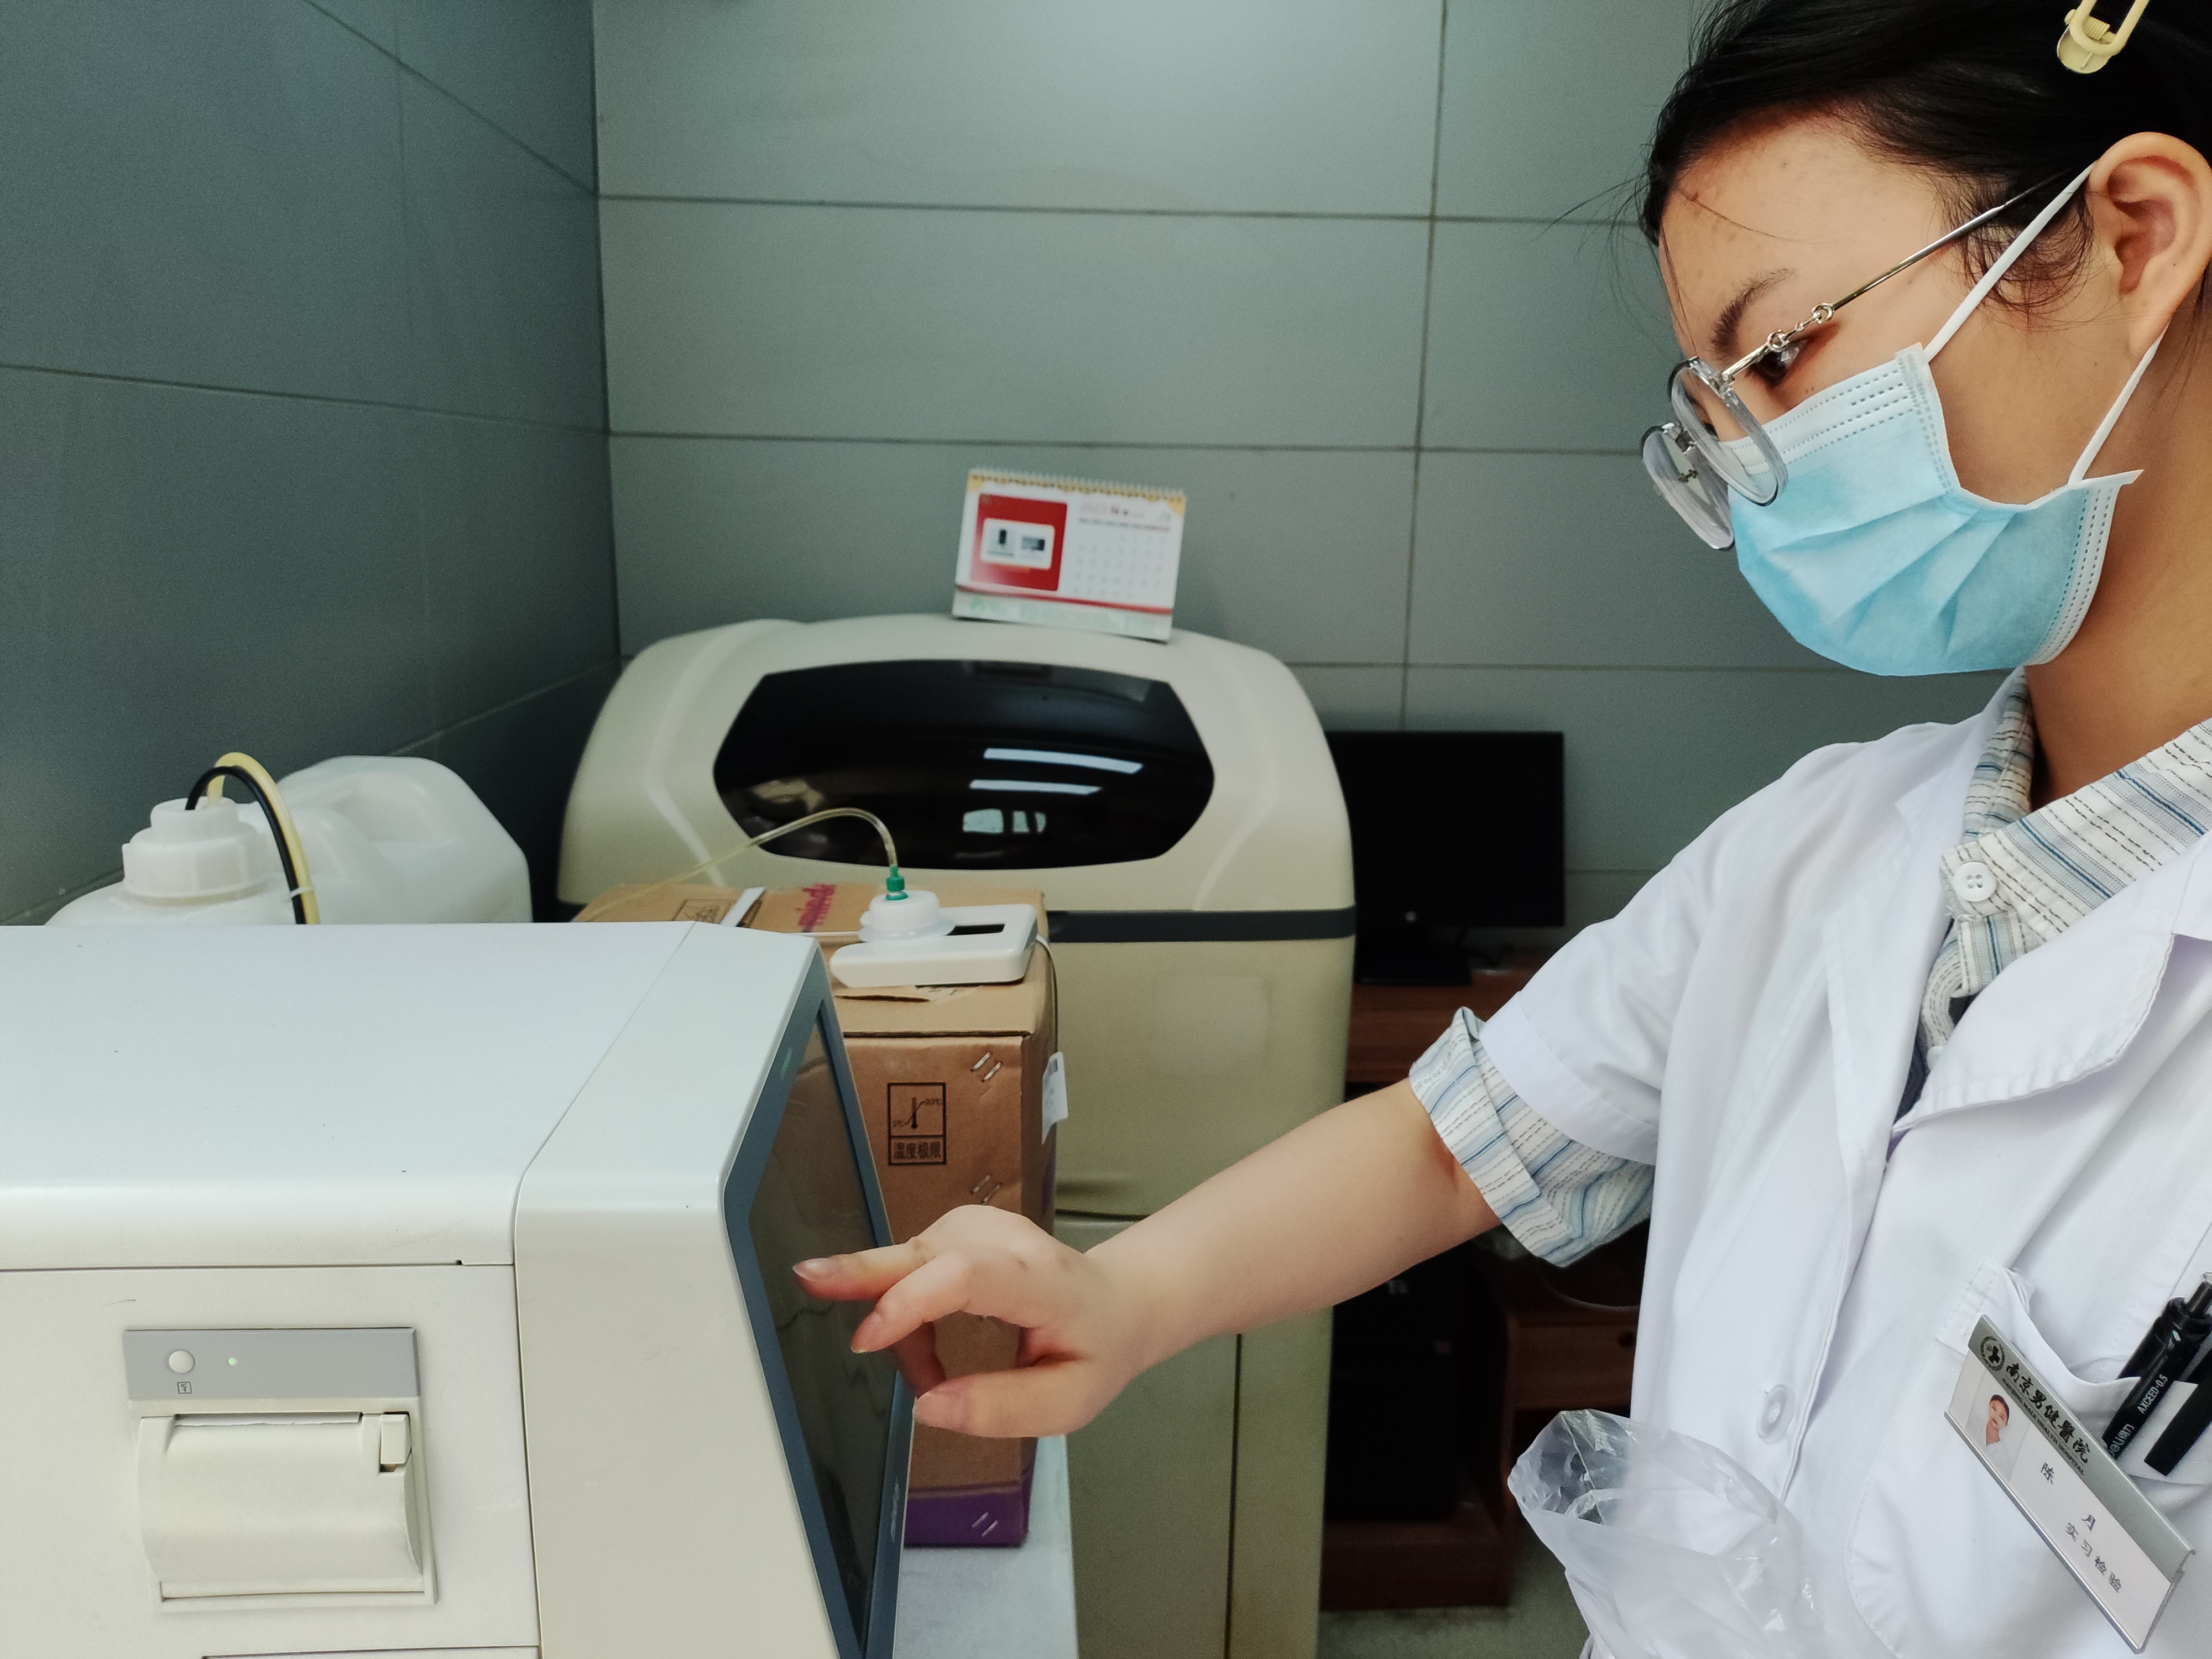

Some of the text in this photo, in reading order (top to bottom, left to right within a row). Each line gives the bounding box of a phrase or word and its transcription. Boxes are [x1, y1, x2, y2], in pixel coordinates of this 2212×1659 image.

[893, 1141, 942, 1159] 温度极限
[2065, 1522, 2122, 1593] 实习检验
